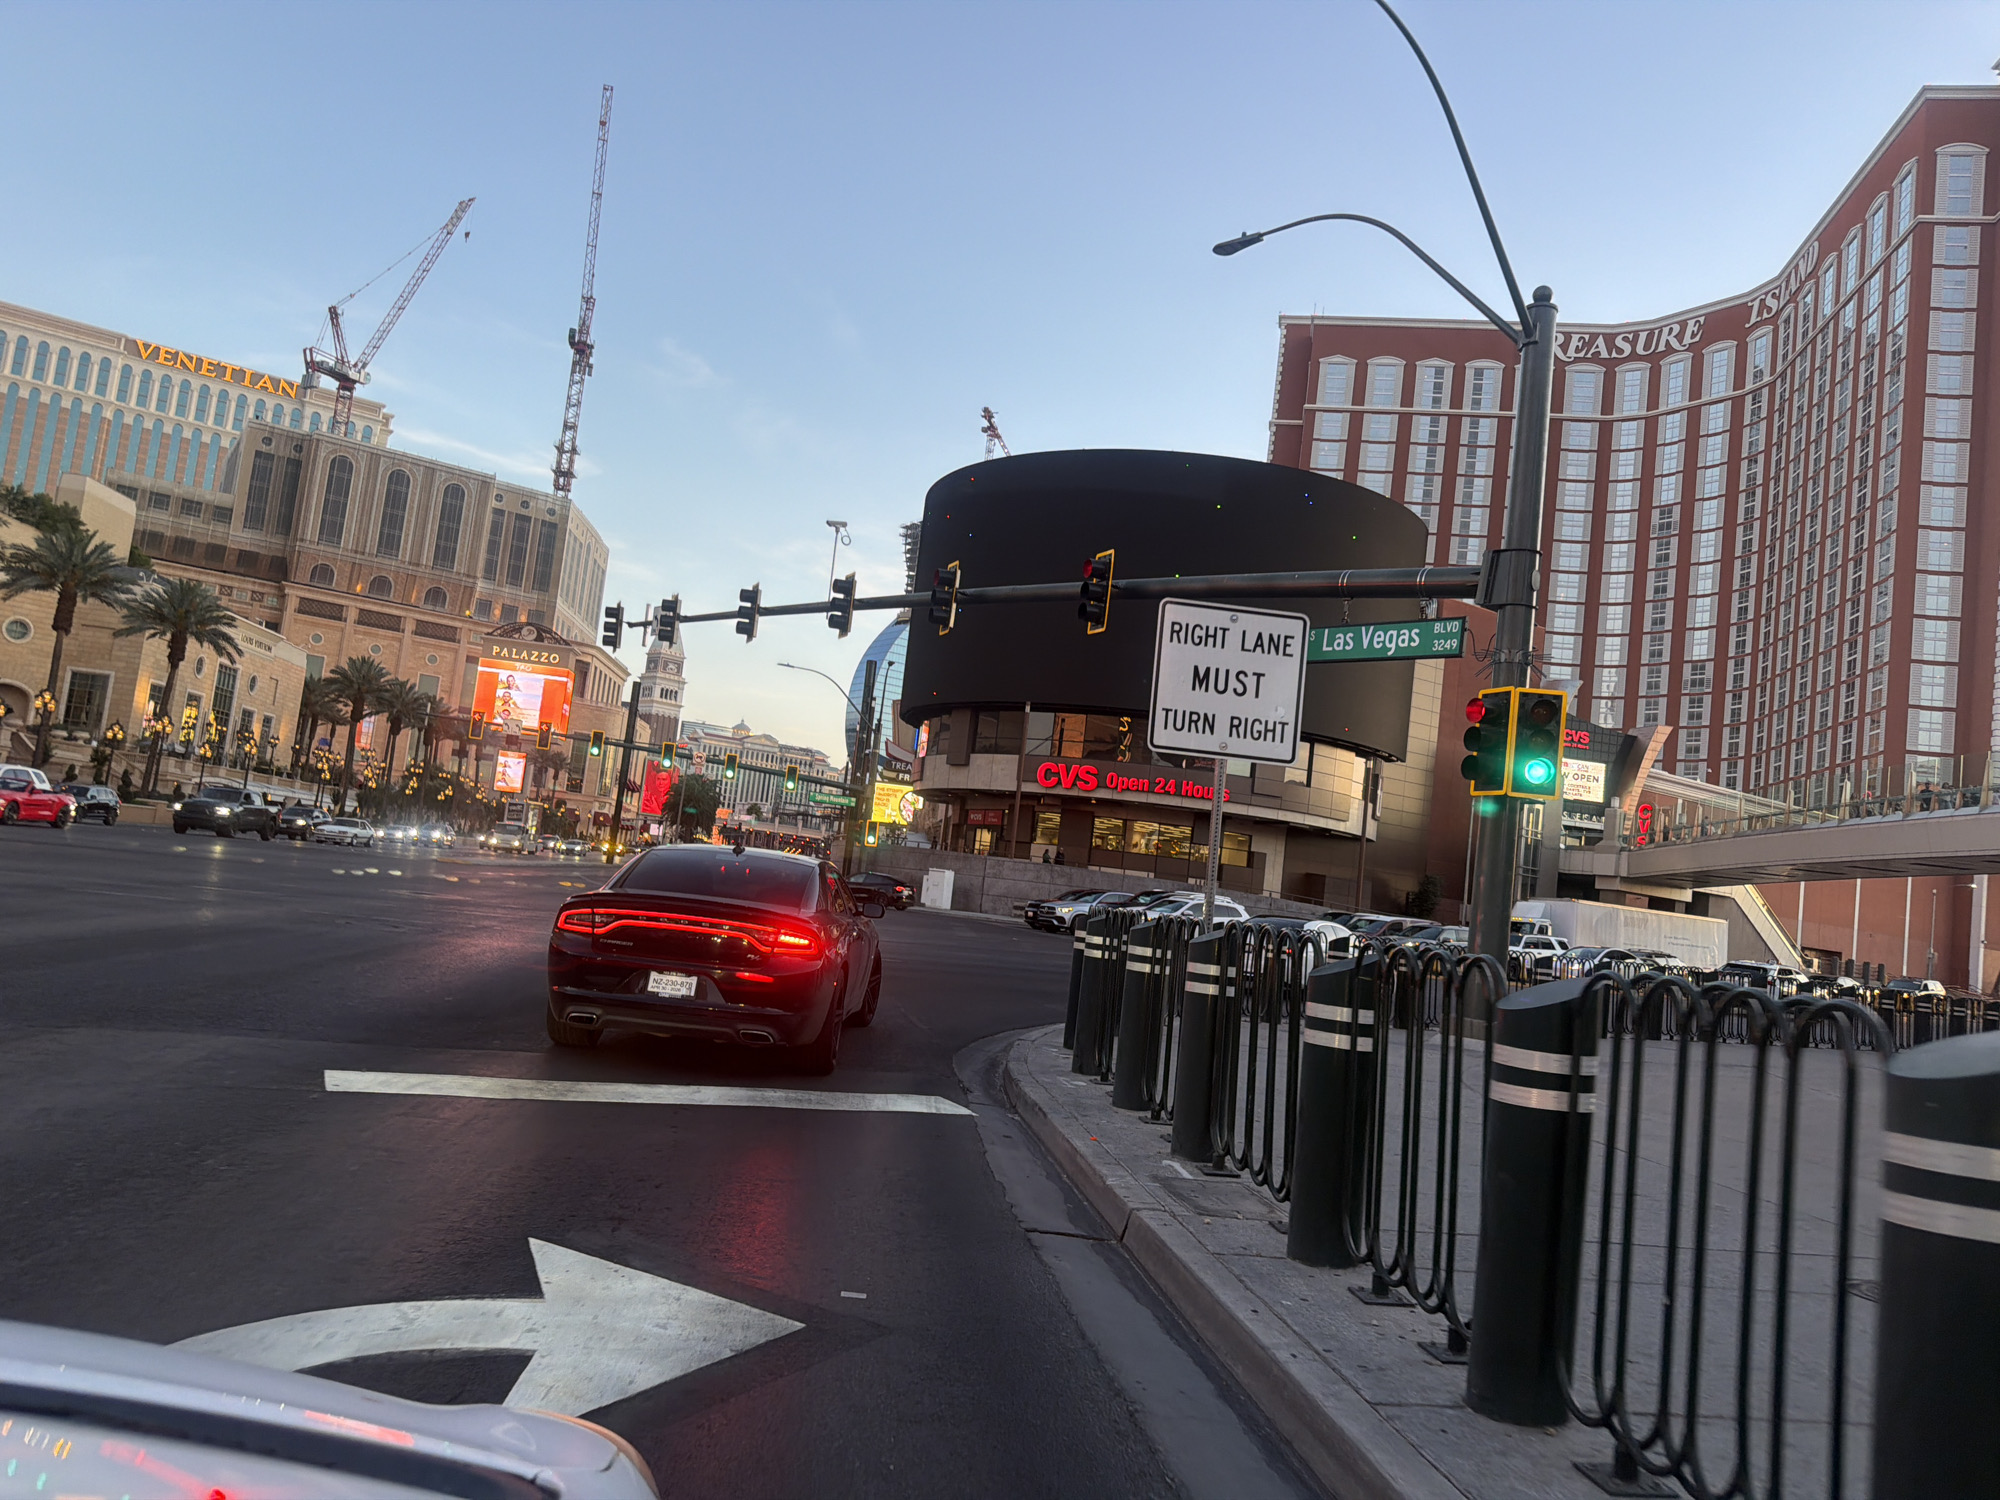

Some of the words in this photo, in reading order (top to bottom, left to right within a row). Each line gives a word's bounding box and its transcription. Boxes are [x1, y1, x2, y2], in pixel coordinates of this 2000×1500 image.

[1553, 316, 1706, 361] REASURE
[1745, 241, 1819, 328] ISLAND
[135, 339, 300, 399] VENETIAN
[492, 645, 560, 664] PALAZZO
[1169, 621, 1230, 649] RIGHT
[1240, 630, 1295, 657] LANE
[1310, 631, 1316, 641] S
[1322, 628, 1354, 651] Las
[1361, 626, 1420, 656] Vegas
[1433, 621, 1459, 634] BLVD
[1432, 639, 1458, 651] 3249
[1191, 665, 1266, 699] MUST
[1161, 707, 1216, 736] TURN
[1228, 716, 1289, 744] RIGHT
[1564, 729, 1590, 744] CVS
[1036, 762, 1099, 791] CVS
[1106, 772, 1150, 793] Open
[1153, 777, 1177, 795] 24
[1181, 780, 1230, 802] Hous
[1572, 773, 1600, 783] OPEN
[1637, 803, 1653, 847] CVS
